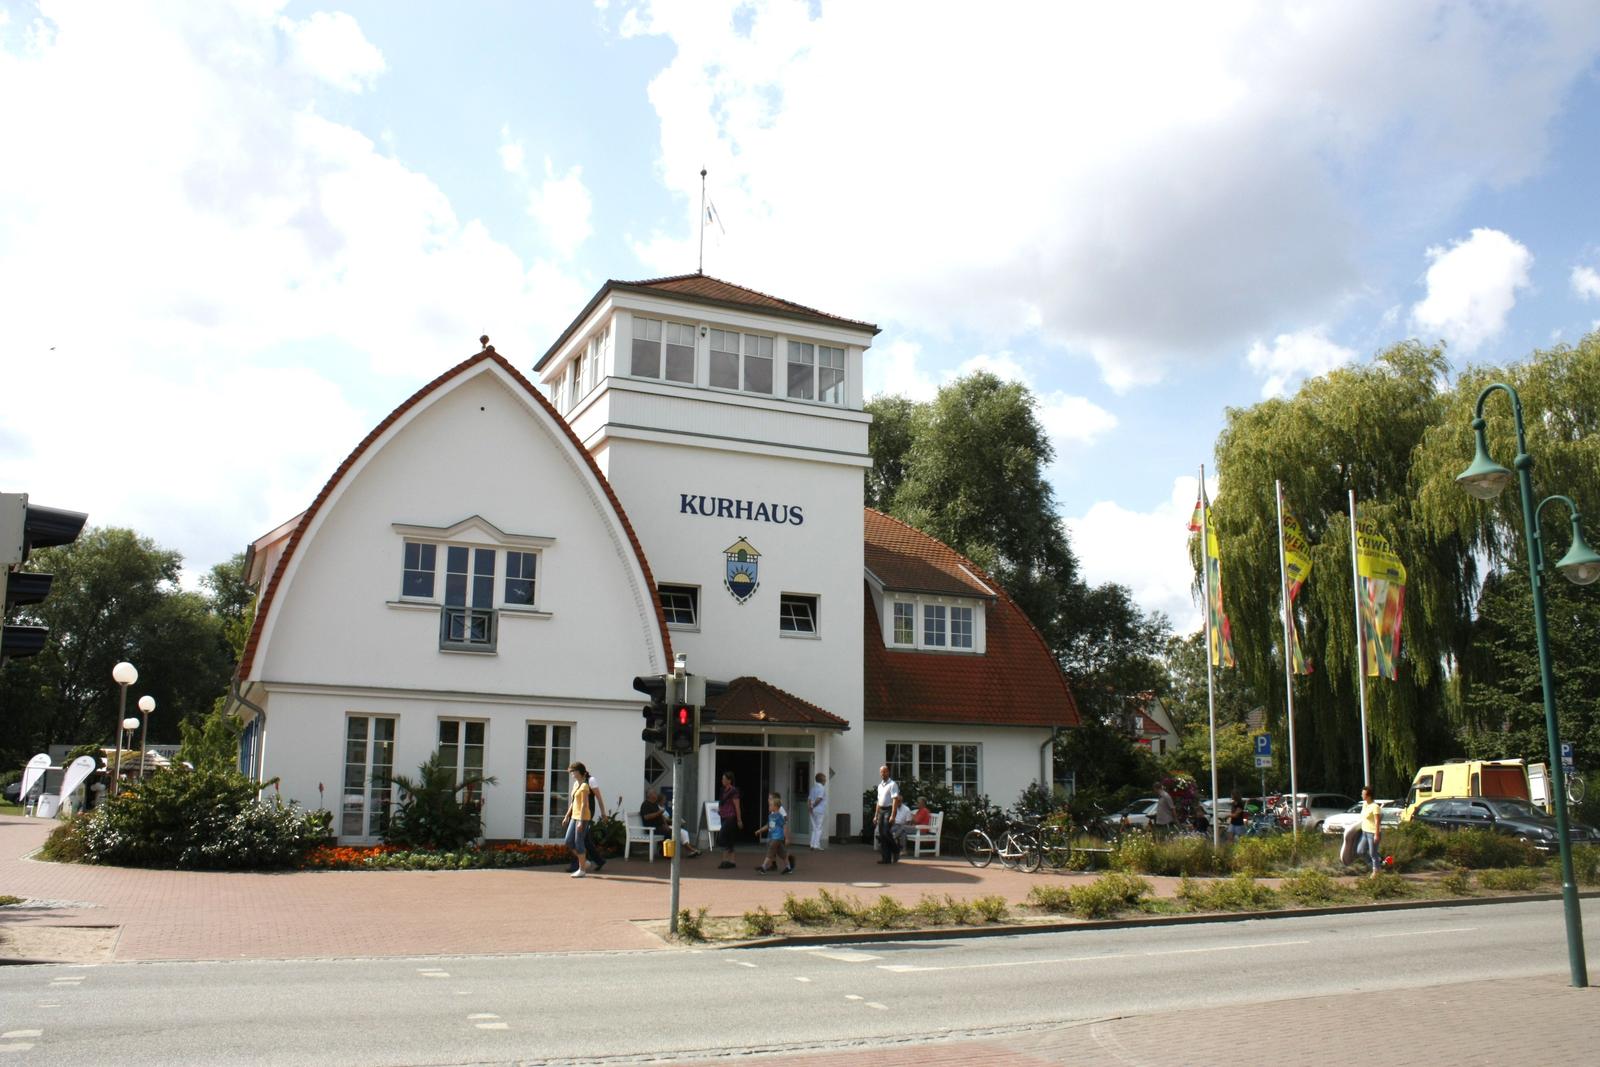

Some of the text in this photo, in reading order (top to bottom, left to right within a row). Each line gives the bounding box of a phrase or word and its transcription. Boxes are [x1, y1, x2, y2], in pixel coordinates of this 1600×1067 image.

[680, 494, 804, 526] KURHAUS
[1257, 736, 1267, 753] P
[1561, 744, 1570, 756] P
